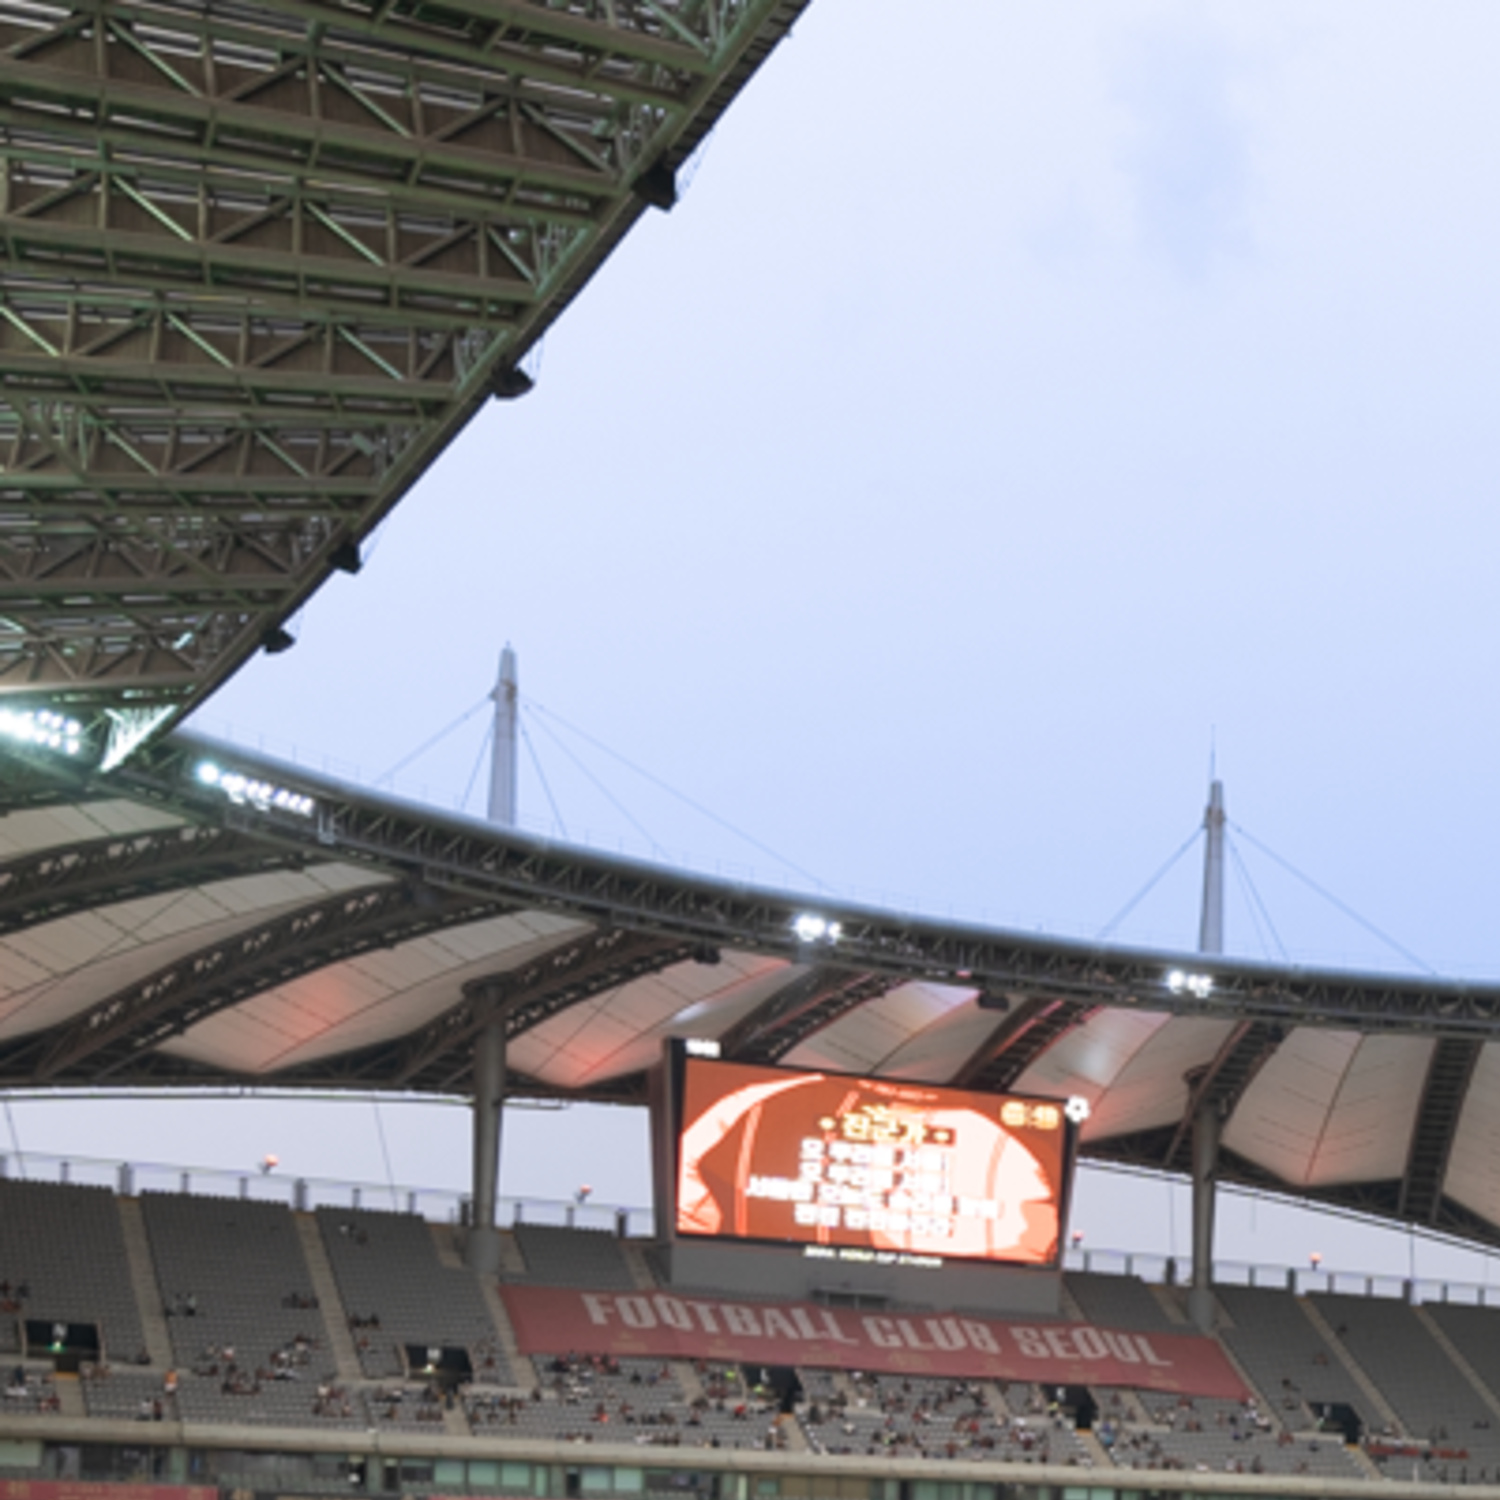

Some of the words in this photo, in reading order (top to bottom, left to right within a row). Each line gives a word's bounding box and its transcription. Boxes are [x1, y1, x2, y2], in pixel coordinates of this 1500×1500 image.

[581, 1293, 858, 1345] FOOTBALL
[862, 1315, 1002, 1355] CLUB
[1009, 1326, 1173, 1367] SEOUL
